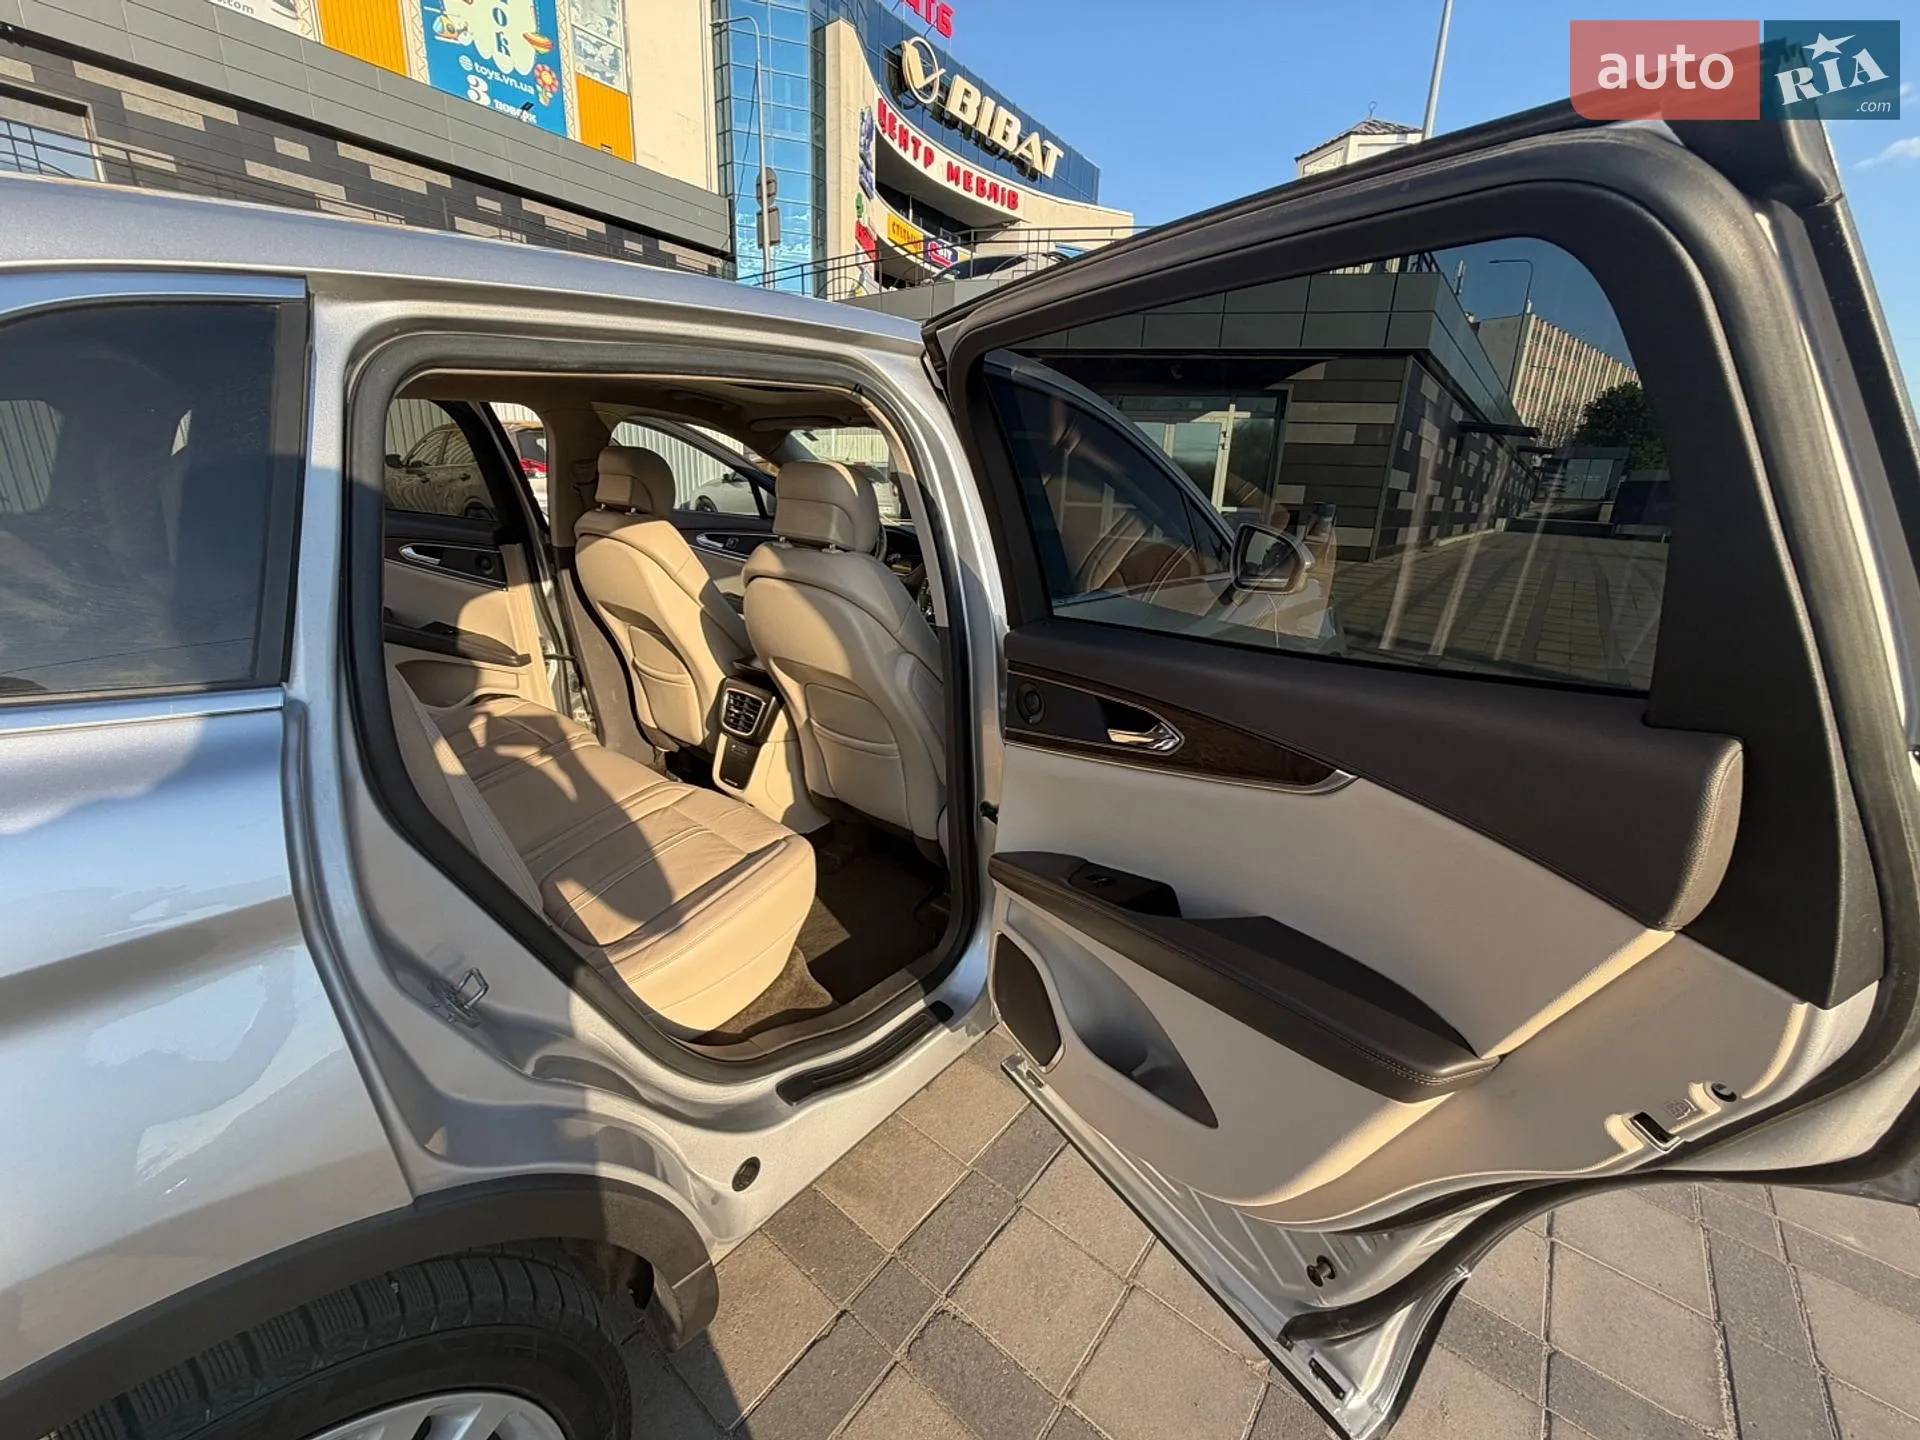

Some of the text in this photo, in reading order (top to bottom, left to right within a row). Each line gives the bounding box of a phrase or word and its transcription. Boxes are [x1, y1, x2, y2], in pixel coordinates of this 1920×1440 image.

[467, 74, 491, 106] 3
[474, 62, 535, 95] toys.vn.ua
[878, 97, 935, 169] ЦЕНТР
